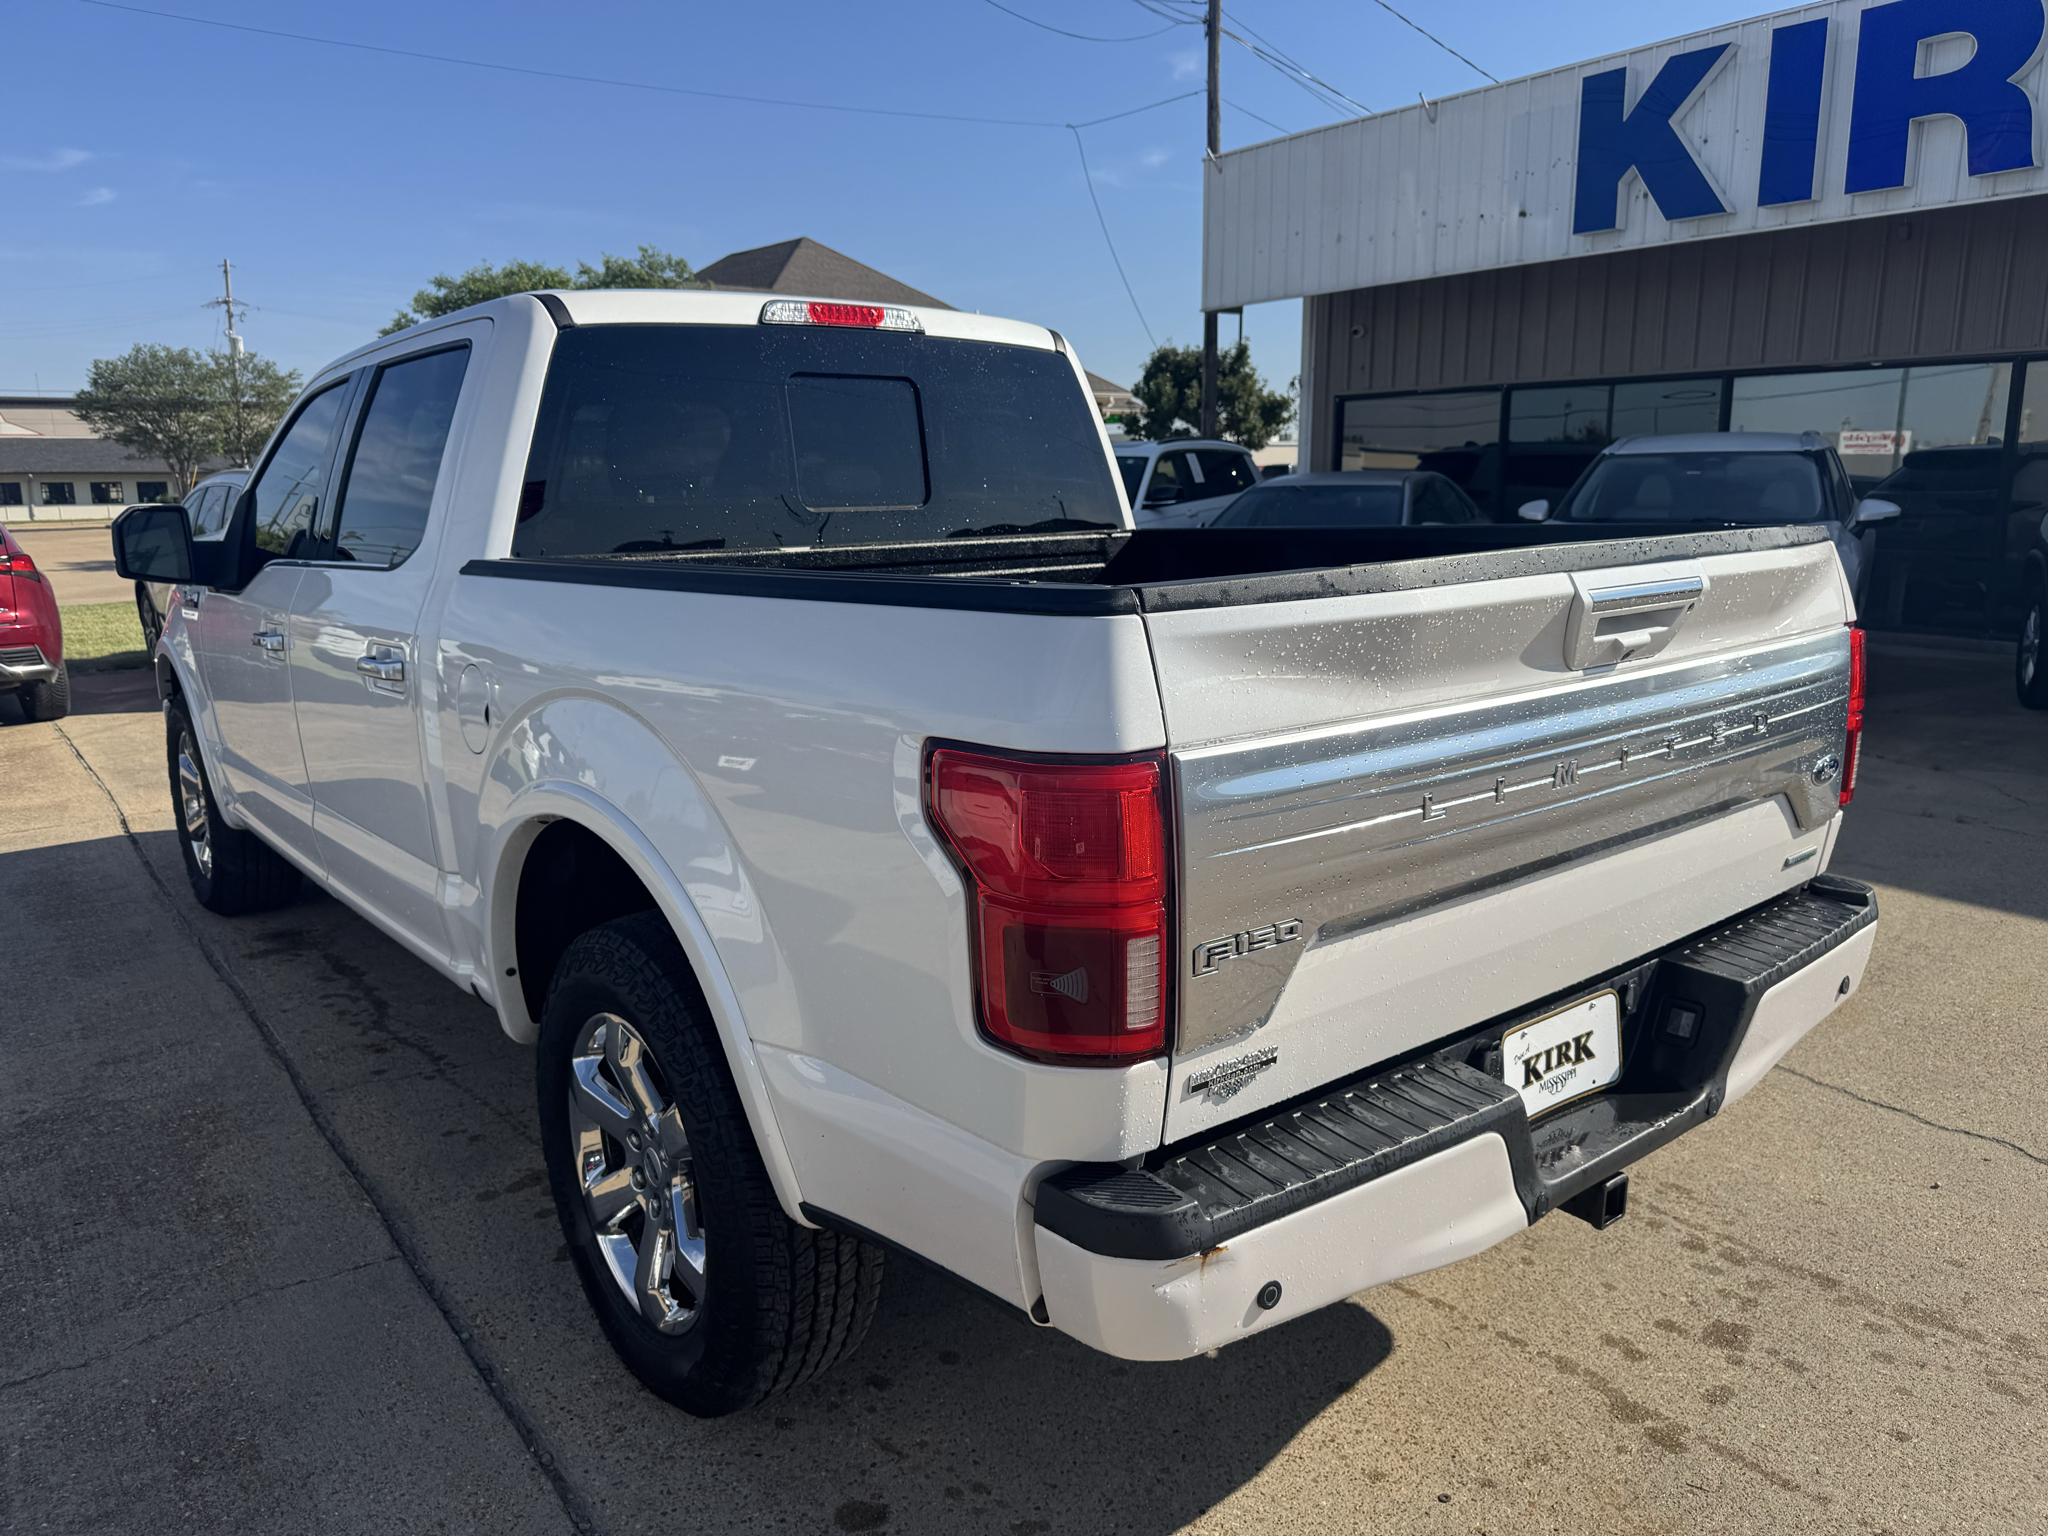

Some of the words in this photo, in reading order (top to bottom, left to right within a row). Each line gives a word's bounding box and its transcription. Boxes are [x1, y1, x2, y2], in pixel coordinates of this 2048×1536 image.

[1573, 0, 2048, 235] KIR
[1422, 711, 1768, 822] LIMITED
[1192, 917, 1303, 979] F150
[1521, 1030, 1596, 1090] KIRK
[1538, 1067, 1577, 1096] MISSISSIPPI
